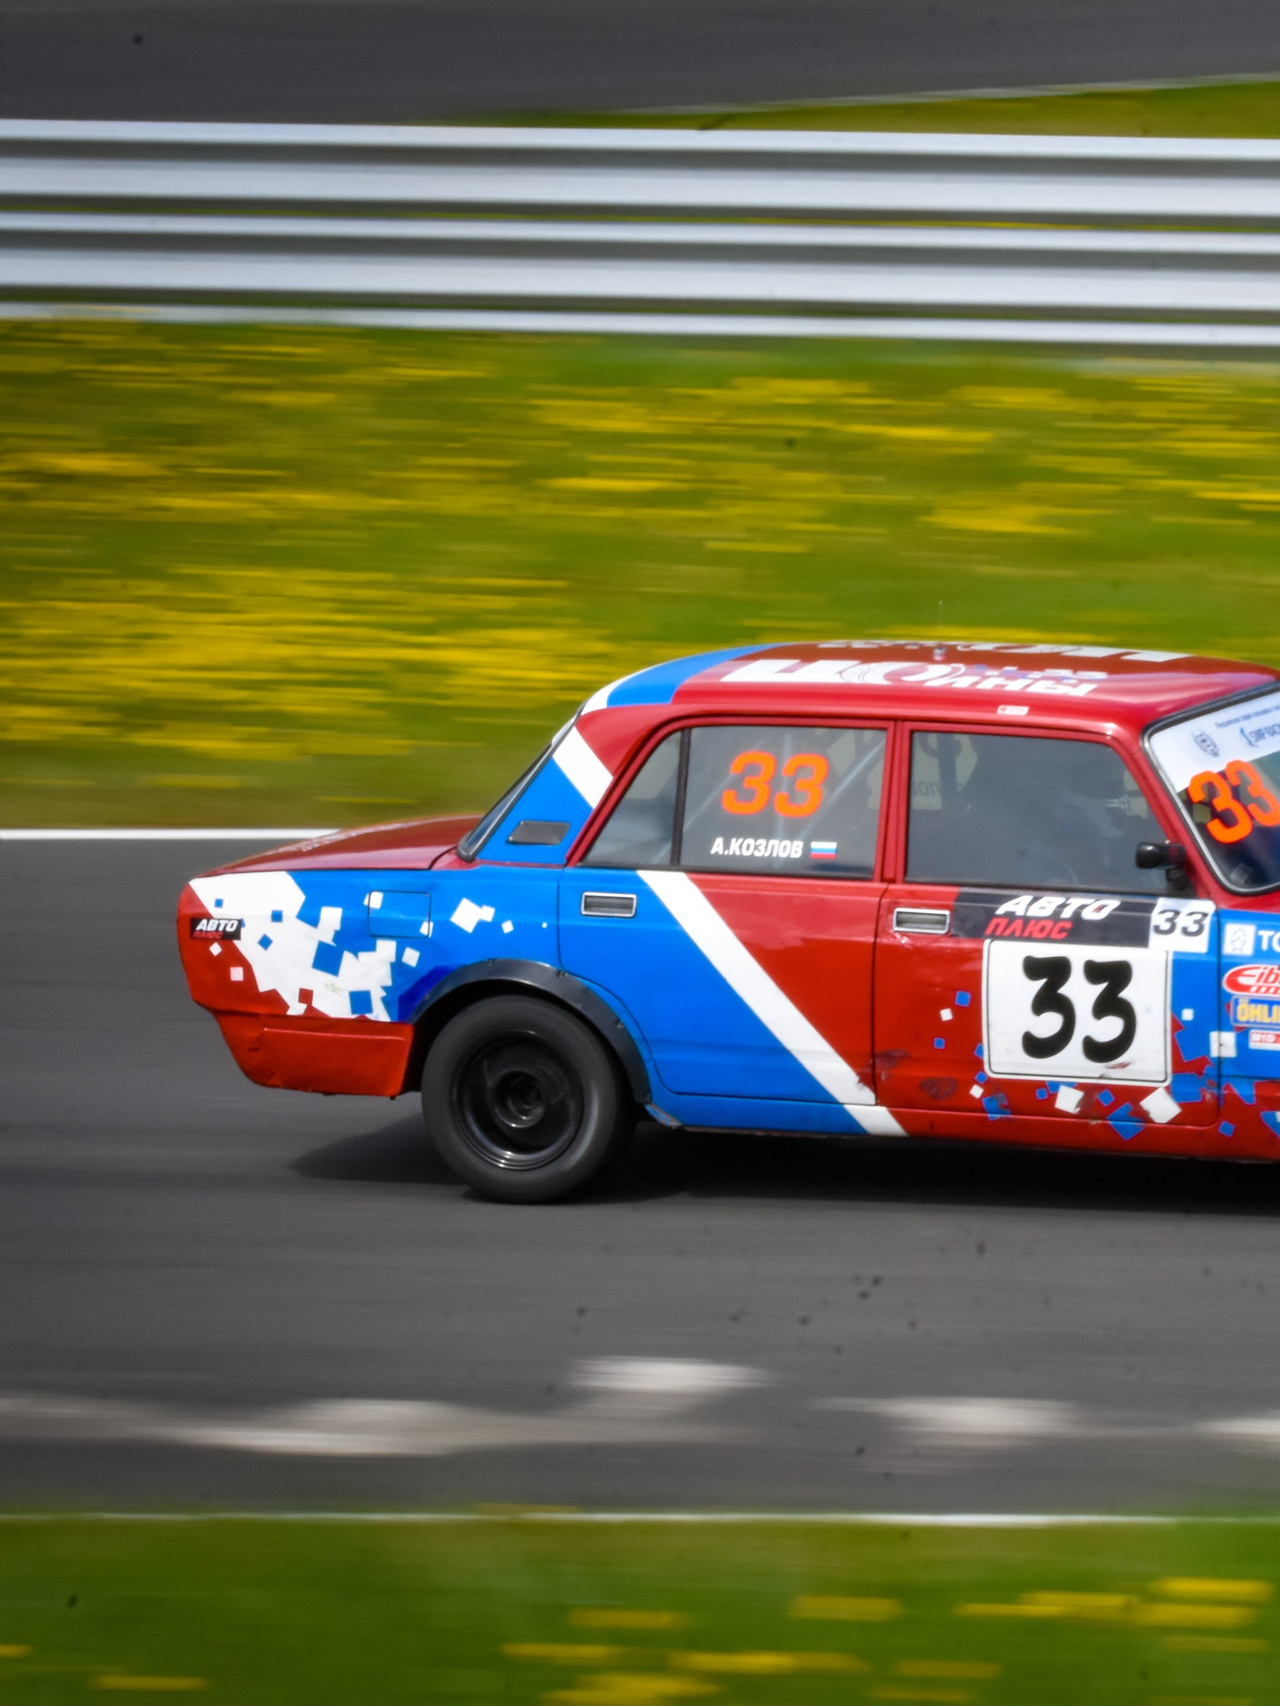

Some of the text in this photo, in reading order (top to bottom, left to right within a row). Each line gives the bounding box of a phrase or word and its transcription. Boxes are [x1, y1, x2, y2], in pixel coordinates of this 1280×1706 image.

[721, 750, 829, 817] 33
[710, 837, 803, 858] А.КОЗЛОВ
[995, 894, 1121, 920] АВТО
[196, 918, 238, 932] АВТО
[985, 917, 1073, 940] ПЛЮС
[1153, 909, 1208, 937] 33
[1022, 955, 1136, 1063] 33
